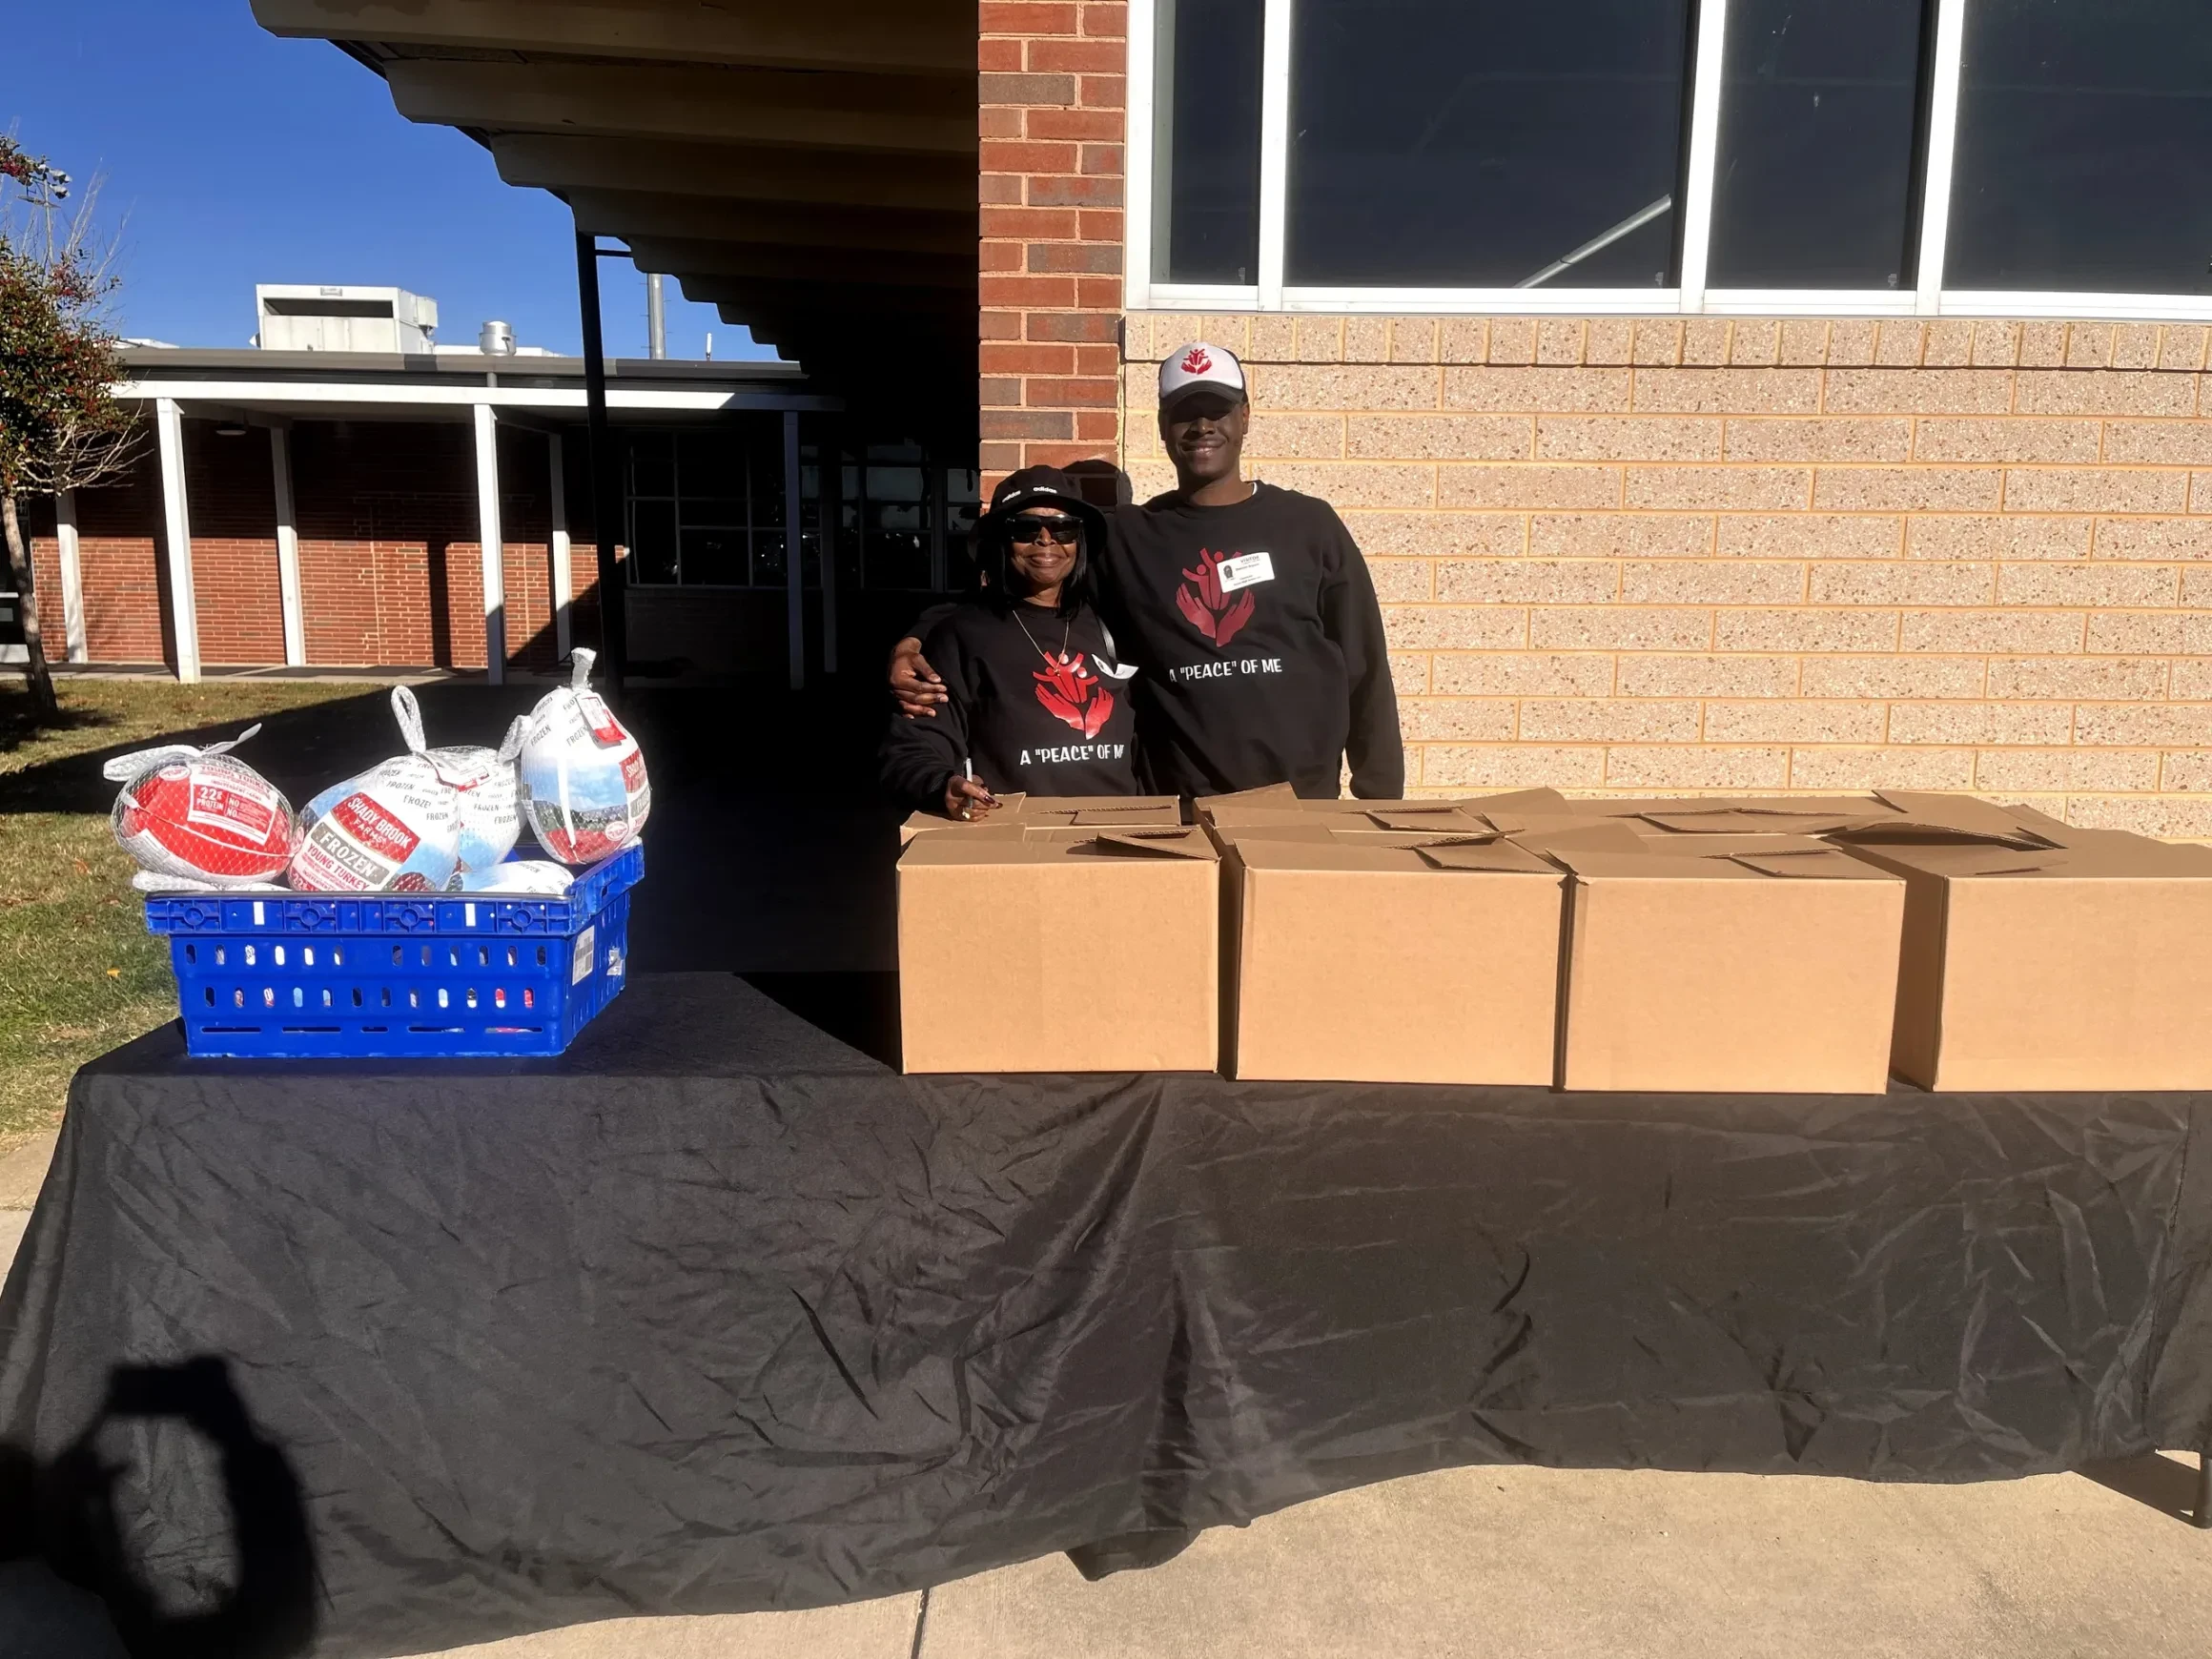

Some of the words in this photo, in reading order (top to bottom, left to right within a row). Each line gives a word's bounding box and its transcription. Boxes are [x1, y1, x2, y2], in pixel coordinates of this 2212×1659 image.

[1169, 668, 1178, 683] A
[1179, 660, 1237, 681] "PEACE"
[1240, 659, 1259, 674] OF
[1261, 658, 1282, 673] ME
[1019, 749, 1032, 766] A
[1034, 745, 1094, 764] "PEACE"
[1096, 744, 1111, 760] OF
[196, 798, 224, 810] PROTEIN
[227, 808, 238, 818] NO
[229, 797, 240, 808] NO
[347, 797, 380, 824] SHADY
[376, 818, 413, 849] BROOK
[353, 819, 383, 843] FARMS
[319, 831, 378, 877] FROZEN
[306, 843, 334, 870] YOUNG
[334, 865, 370, 891] TURKEY
